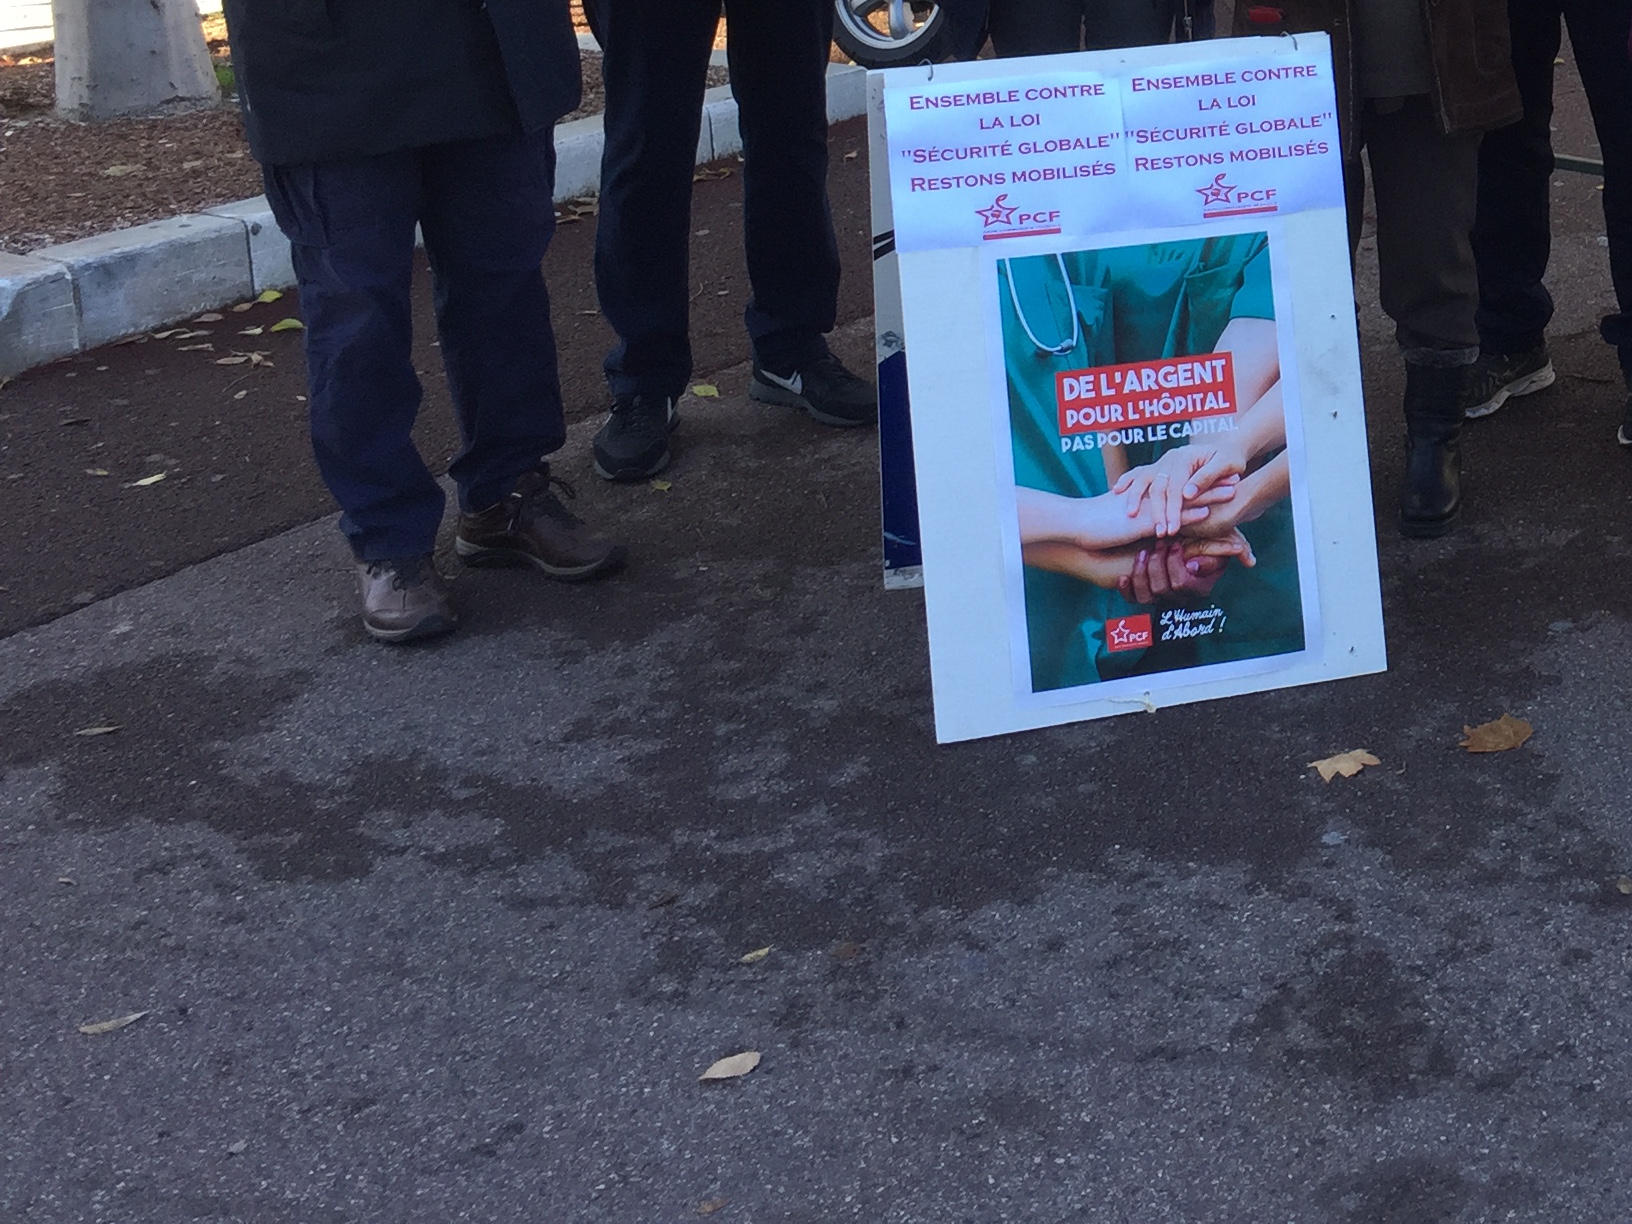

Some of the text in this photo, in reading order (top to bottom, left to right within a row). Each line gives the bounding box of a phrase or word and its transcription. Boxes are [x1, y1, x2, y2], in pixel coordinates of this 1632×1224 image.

[1241, 65, 1317, 83] CONTRE
[1025, 84, 1105, 101] CONTRE
[1199, 95, 1256, 111] LA LOI
[980, 114, 1041, 130] LA LOI
[1135, 152, 1224, 172] RESTONS
[911, 172, 1006, 192] RESTONS
[1237, 189, 1277, 203] PCF
[1019, 211, 1061, 225] PCF
[1063, 359, 1226, 401] DE L'ARGENT
[1066, 390, 1230, 428] POUR L'HÔPITAL
[1061, 416, 1239, 453] PAS POUR LE CAPITAL
[1129, 631, 1149, 642] PCF
